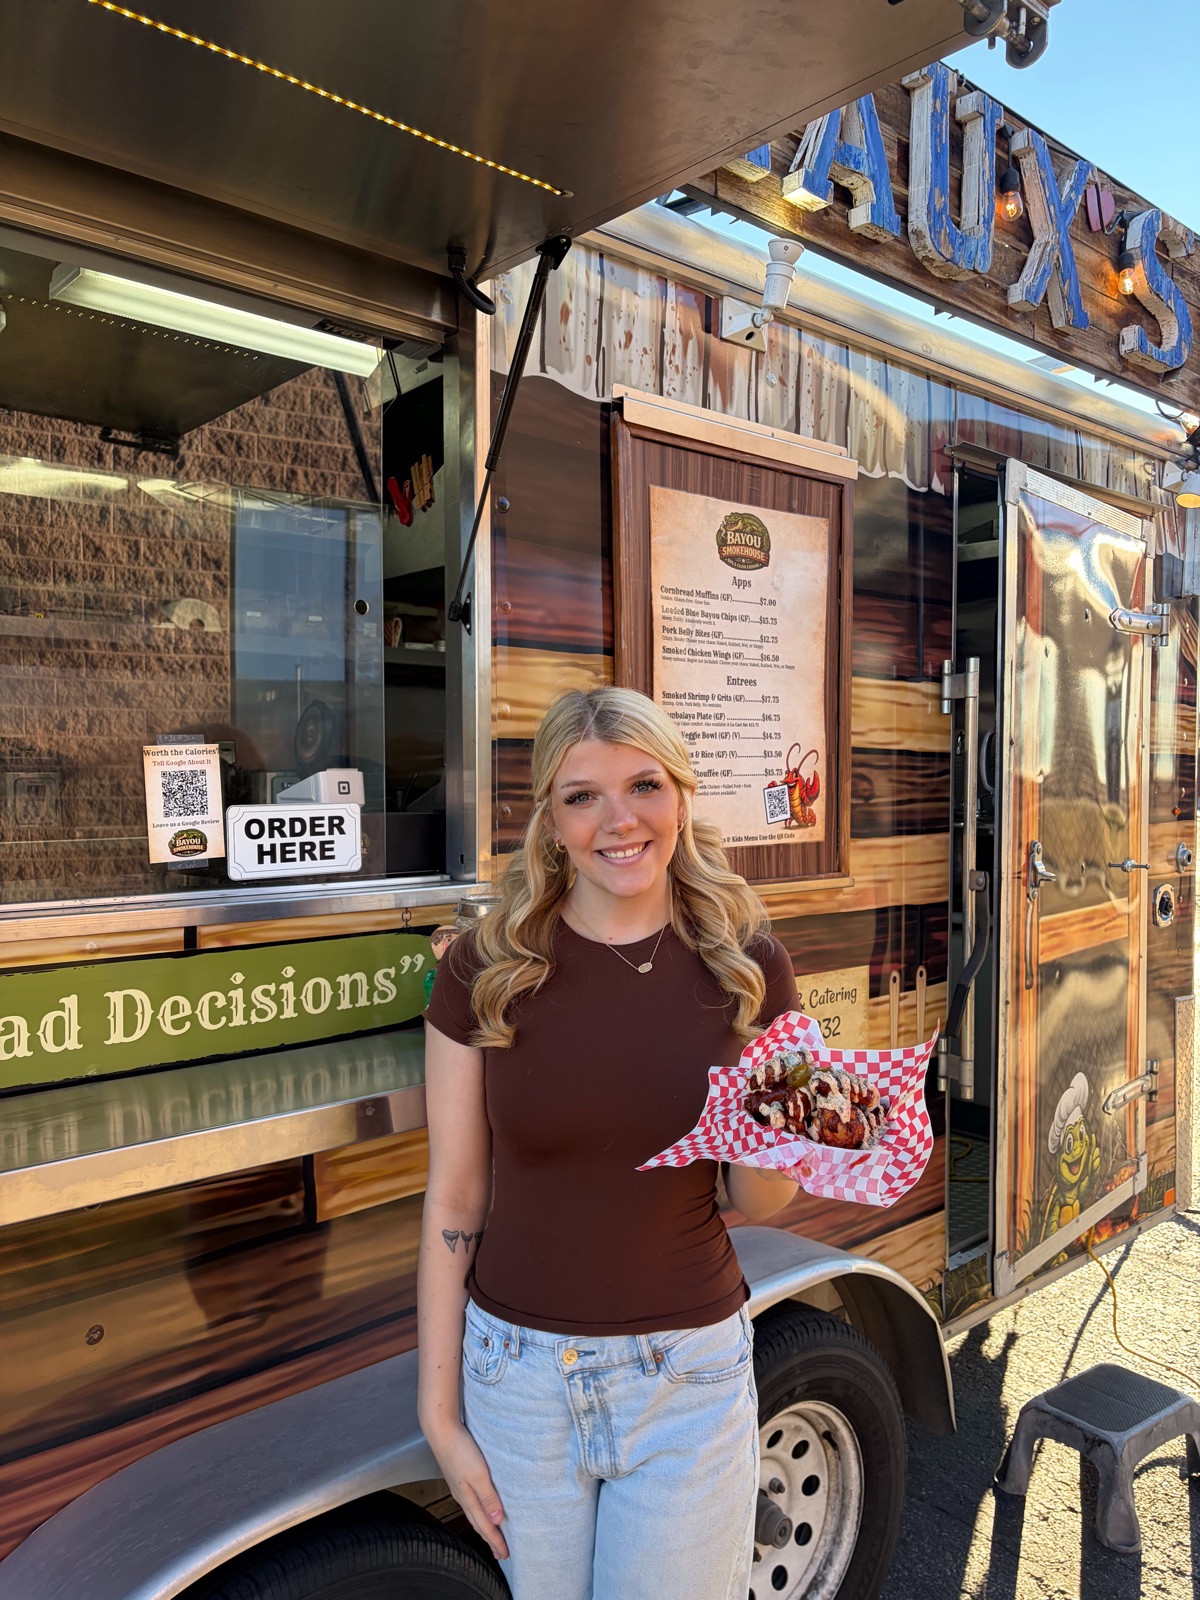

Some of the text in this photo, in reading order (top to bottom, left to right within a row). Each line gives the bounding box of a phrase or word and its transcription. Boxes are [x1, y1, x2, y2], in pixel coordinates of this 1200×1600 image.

[727, 531, 761, 549] BAYOU
[722, 546, 765, 562] SMOKEHOUSE
[731, 576, 752, 589] Apps
[660, 584, 777, 607] Cornbread Muffins (GF) $7.00
[661, 604, 685, 616] Loaded
[685, 608, 700, 617] Blue
[700, 610, 720, 620] Bayou
[720, 612, 738, 623] Chips
[738, 614, 750, 624] (GF)
[661, 625, 779, 644] Pork Belly Bites (GF) $12.75
[661, 645, 780, 663] Smoked Chicken Wings (GF) $16.50
[726, 675, 757, 687] Entrees
[661, 690, 780, 704] Smoked Shrimp & Grits (GF) $17.75
[664, 710, 781, 722] mbalaya Plate (GF) $16.75
[680, 731, 782, 741] Veggie Bowl (GF) (V) $14.75
[142, 749, 169, 757] Worth
[170, 748, 184, 756] the
[694, 750, 700, 758] &
[700, 750, 715, 758] Rice
[715, 750, 728, 759] (GF)
[728, 750, 738, 759] (V)
[763, 749, 782, 759] $13.50
[187, 758, 206, 766] About
[720, 769, 733, 778] (GF)
[764, 768, 783, 777] $15.75
[200, 818, 220, 826] Review
[244, 815, 347, 840] ORDER
[176, 838, 201, 847] BAYOU
[257, 840, 336, 865] HERE
[809, 986, 858, 1009] Catering
[819, 1015, 841, 1039] 32
